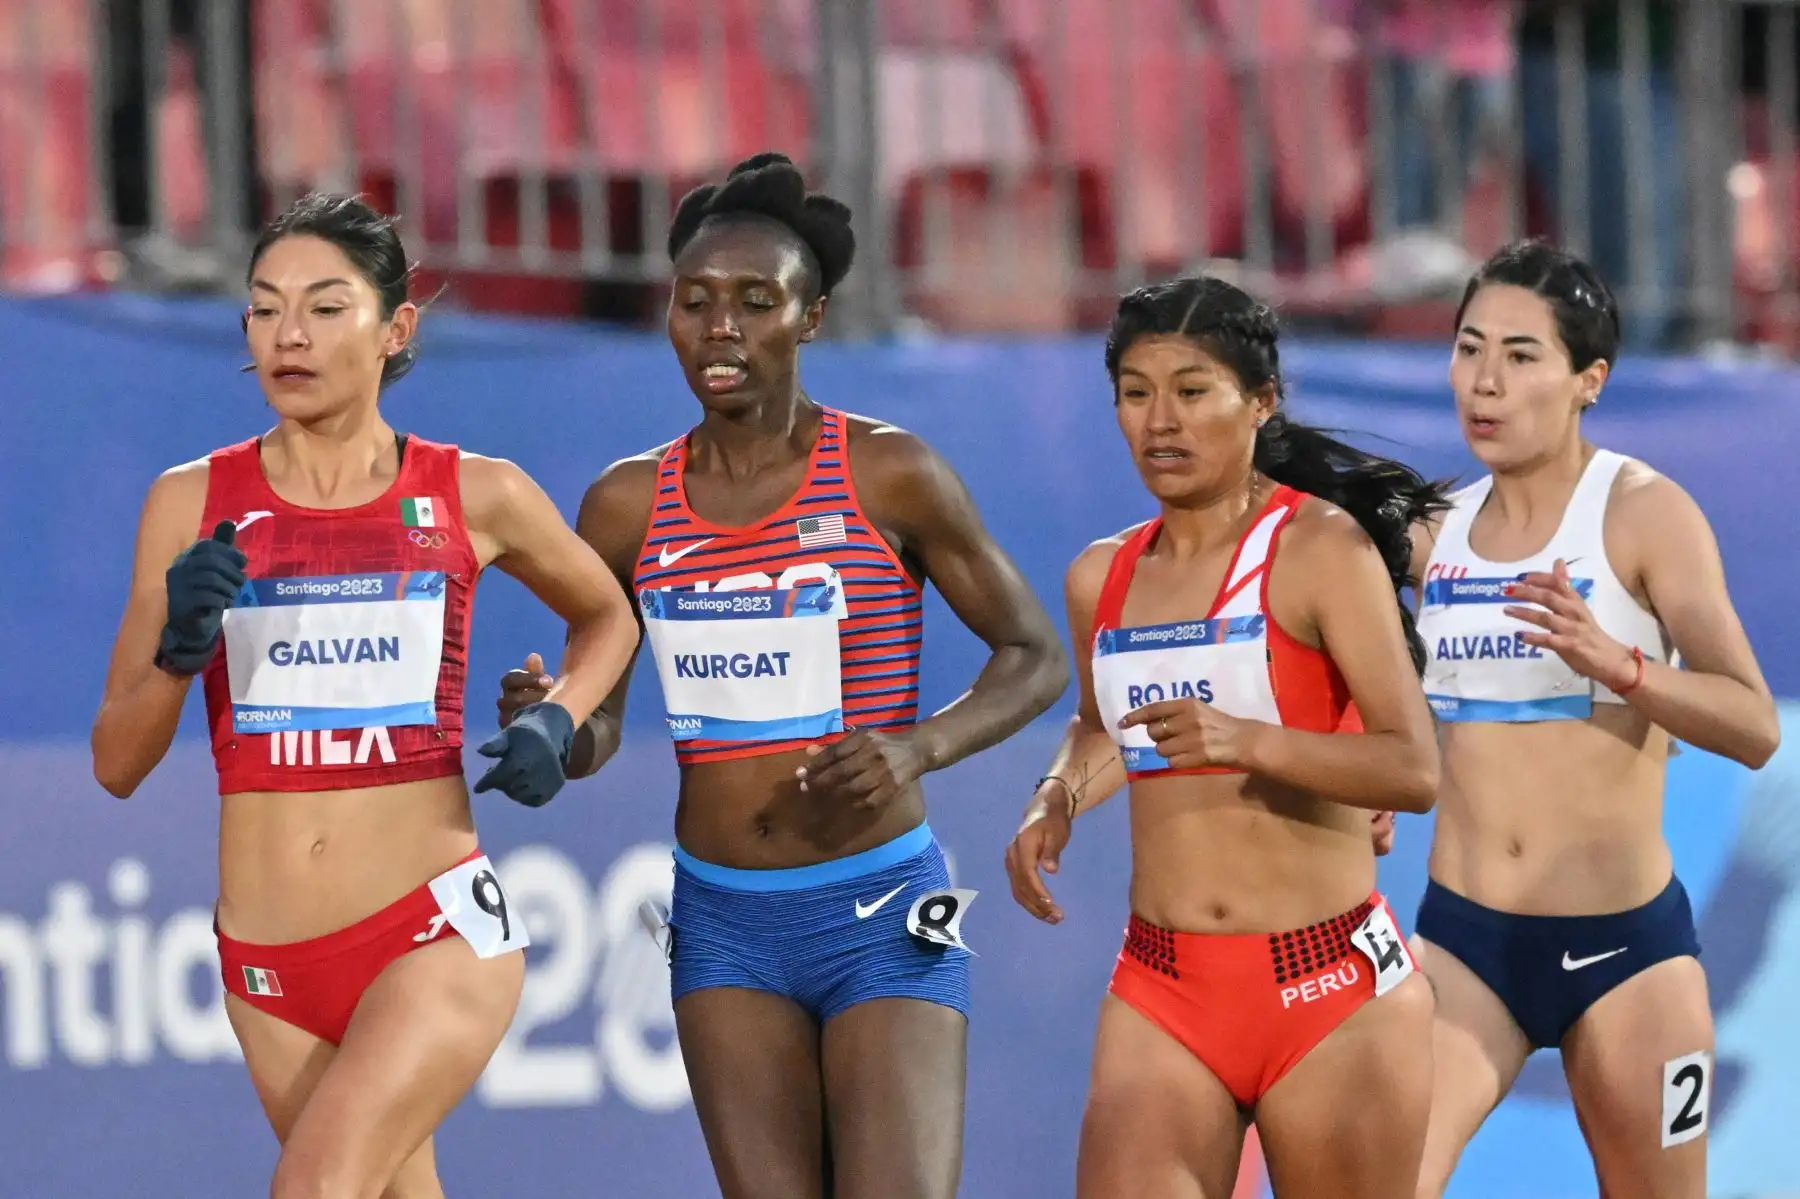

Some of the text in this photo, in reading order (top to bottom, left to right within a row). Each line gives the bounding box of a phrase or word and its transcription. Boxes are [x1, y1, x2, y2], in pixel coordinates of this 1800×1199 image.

[276, 579, 383, 596] Santiago 2023
[1452, 582, 1500, 597] Santiago
[677, 596, 772, 612] Santiago 2023
[1129, 623, 1206, 642] Santiago 2023
[268, 637, 400, 667] GALVAN
[1436, 634, 1544, 661] ALVAREZ
[674, 652, 790, 679] KURGAT
[1128, 679, 1214, 709] ROJAS
[471, 869, 510, 942] 9
[1364, 926, 1405, 975] 4
[1280, 961, 1359, 1009] PERÚ
[1669, 1063, 1704, 1136] 2
